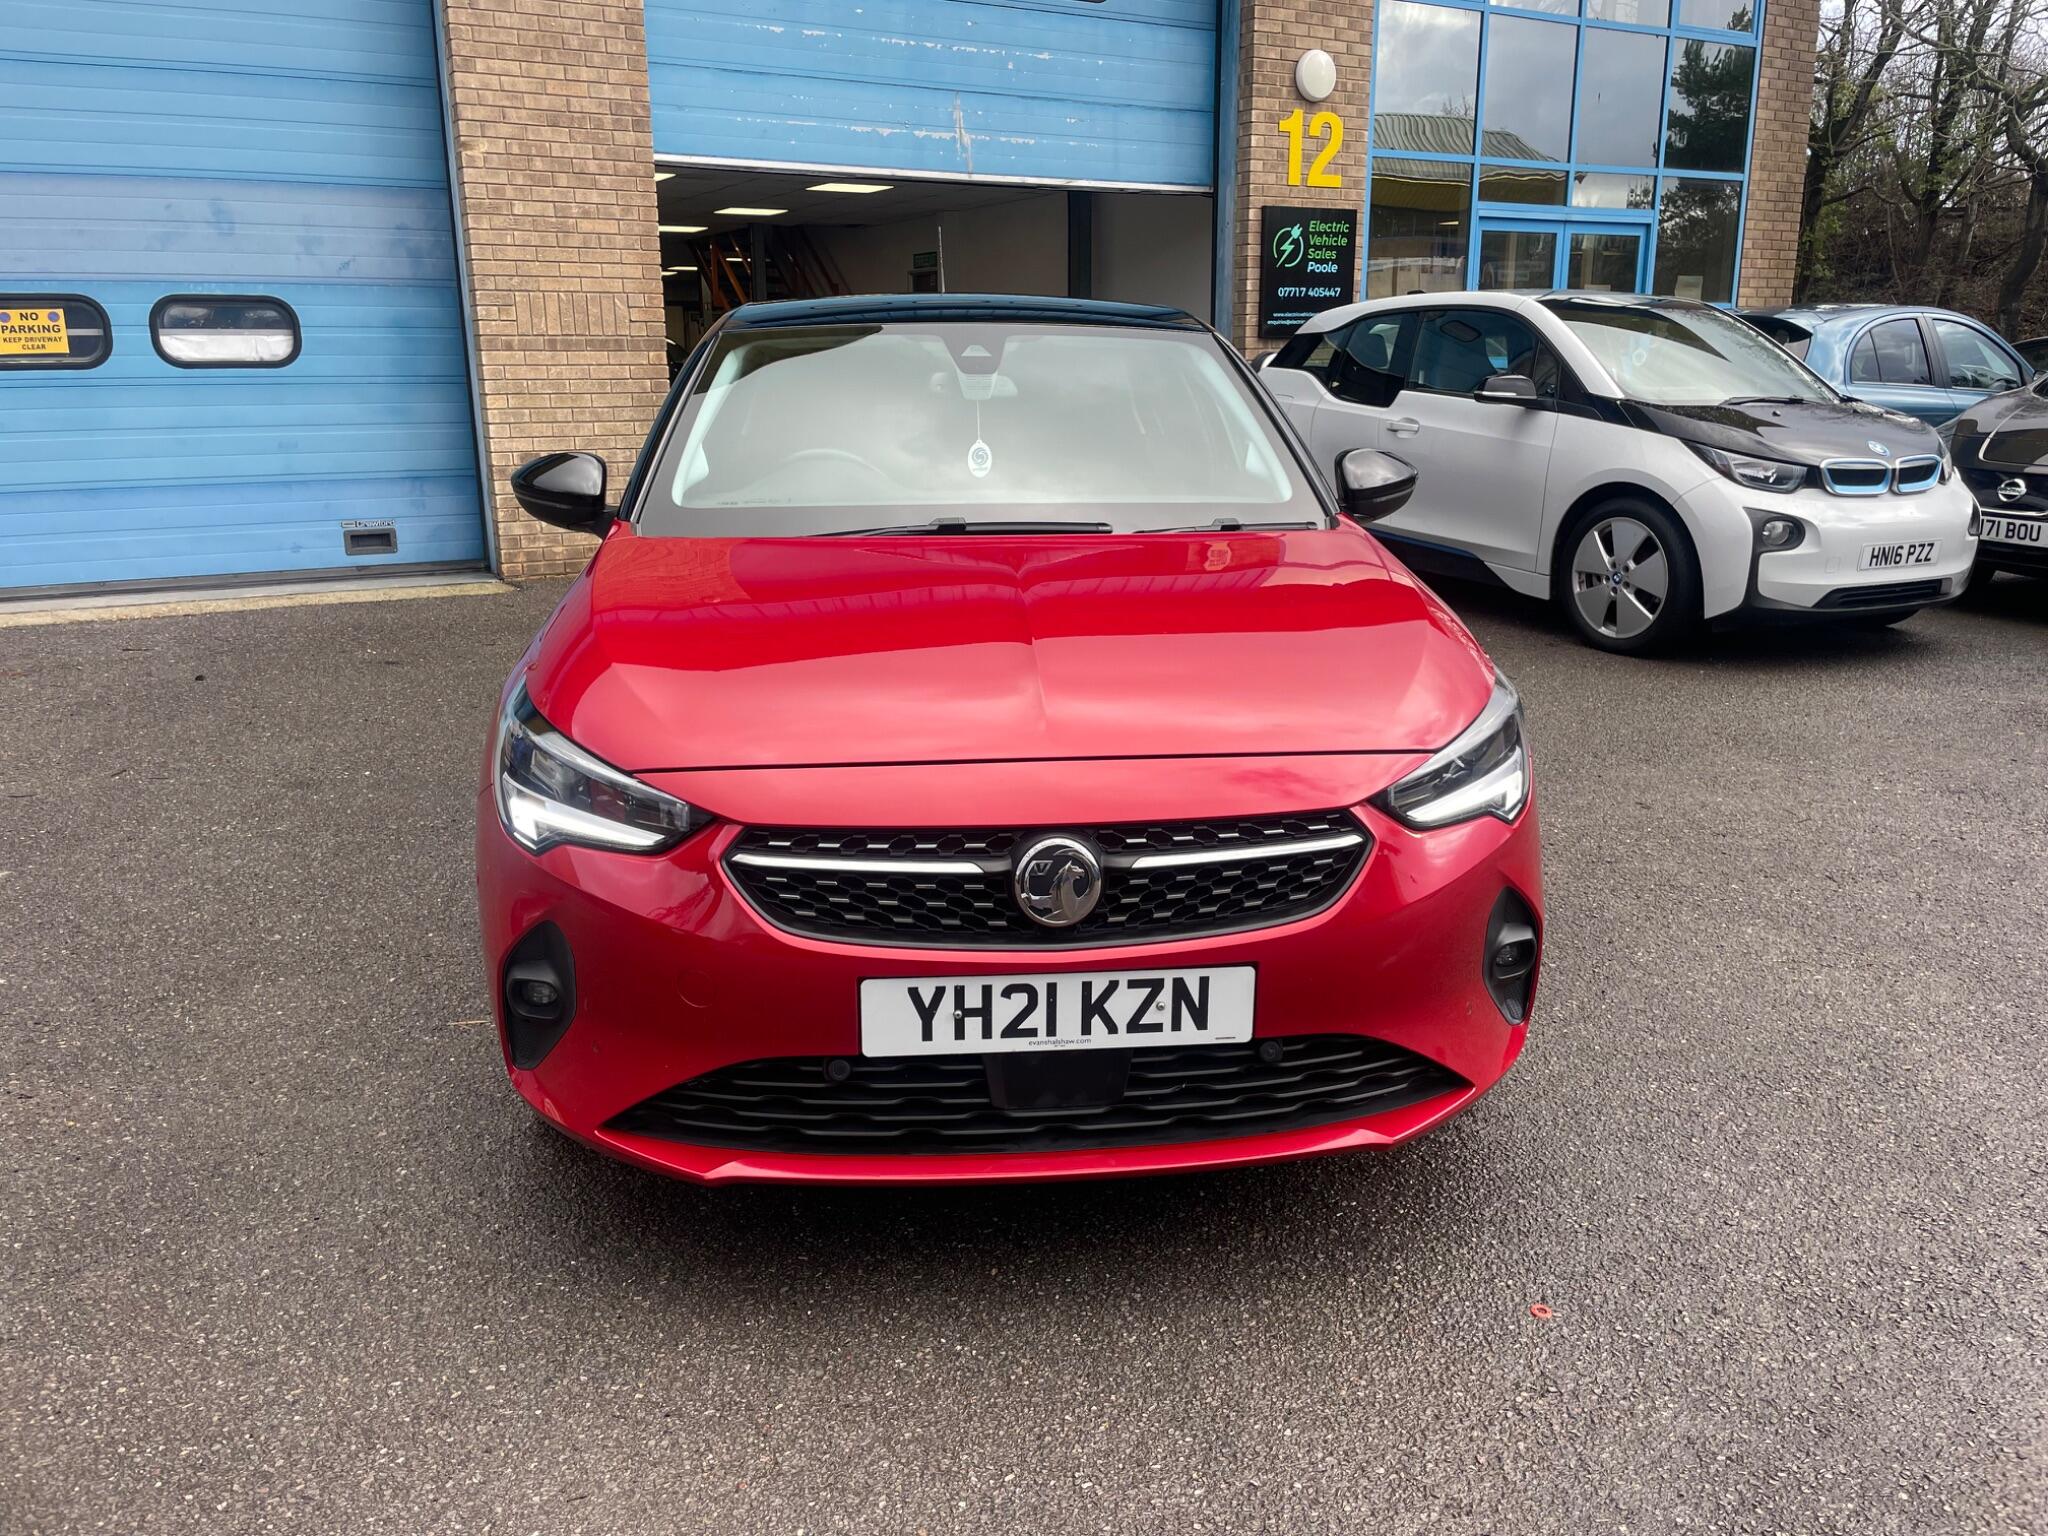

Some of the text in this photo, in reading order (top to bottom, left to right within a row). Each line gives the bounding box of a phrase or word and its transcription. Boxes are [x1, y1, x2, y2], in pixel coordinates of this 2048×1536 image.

[1279, 108, 1343, 187] 12
[1308, 220, 1349, 232] Electric
[1308, 234, 1348, 246] Vehicle
[1307, 248, 1337, 259] Sales
[1307, 261, 1338, 273] Poole
[1278, 287, 1341, 297] 07717 405447
[19, 312, 39, 321] NO
[1, 324, 61, 334] PARKING
[2004, 521, 2042, 542] BOU
[1869, 542, 1935, 567] HN16 PZZ
[907, 975, 1210, 1042] YH21 KZN
[1028, 1038, 1092, 1046] evanshalshaw.com
